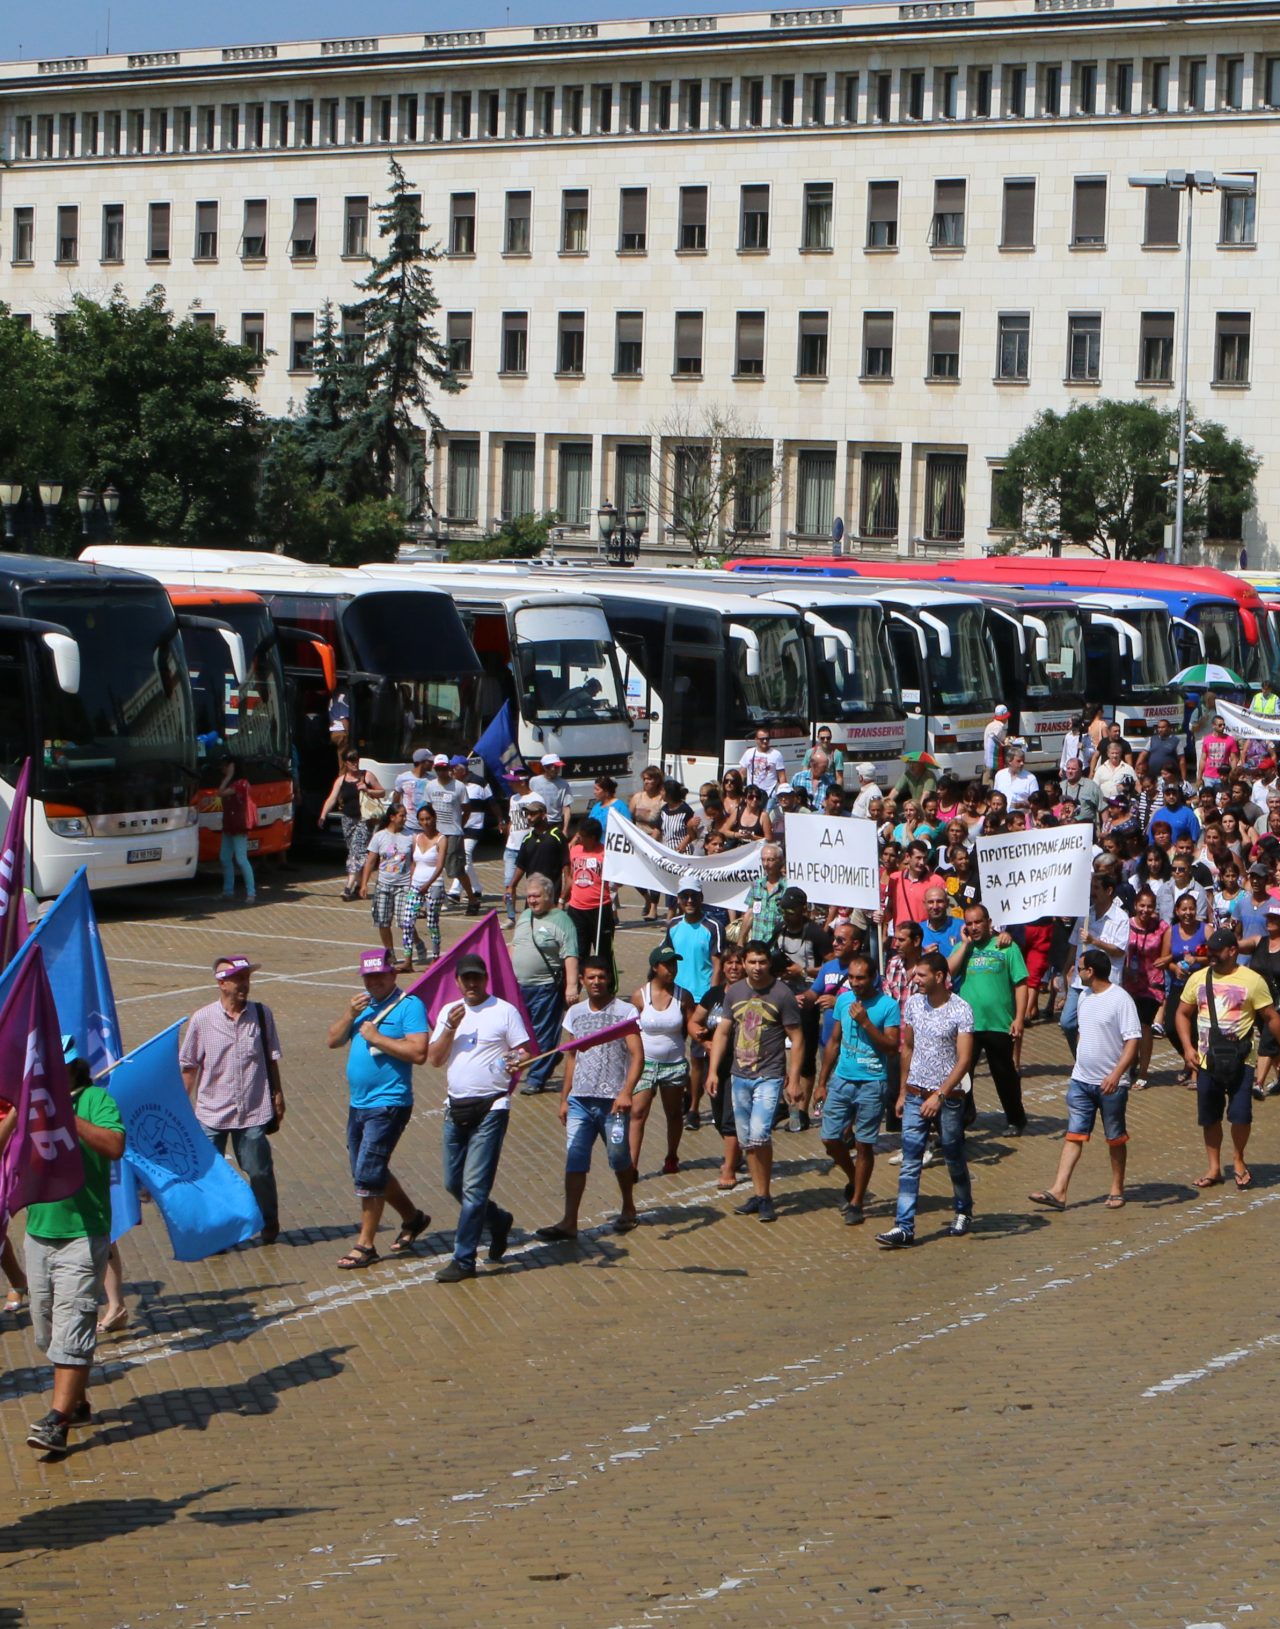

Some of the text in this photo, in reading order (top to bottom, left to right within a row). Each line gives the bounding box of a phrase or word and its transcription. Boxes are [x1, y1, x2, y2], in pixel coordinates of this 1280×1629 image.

[847, 725, 905, 739] TRANSSERVICE
[118, 816, 169, 829] SETRA
[819, 828, 845, 849] ДА
[980, 838, 1058, 863] ПРОТЕСТИРАМЕ
[788, 861, 876, 889] НА РЕФОРМИТЕ!
[986, 862, 1073, 889] ЗА ДА РАБОТИМ
[1000, 898, 1011, 912] И
[363, 958, 383, 968] КНСБ
